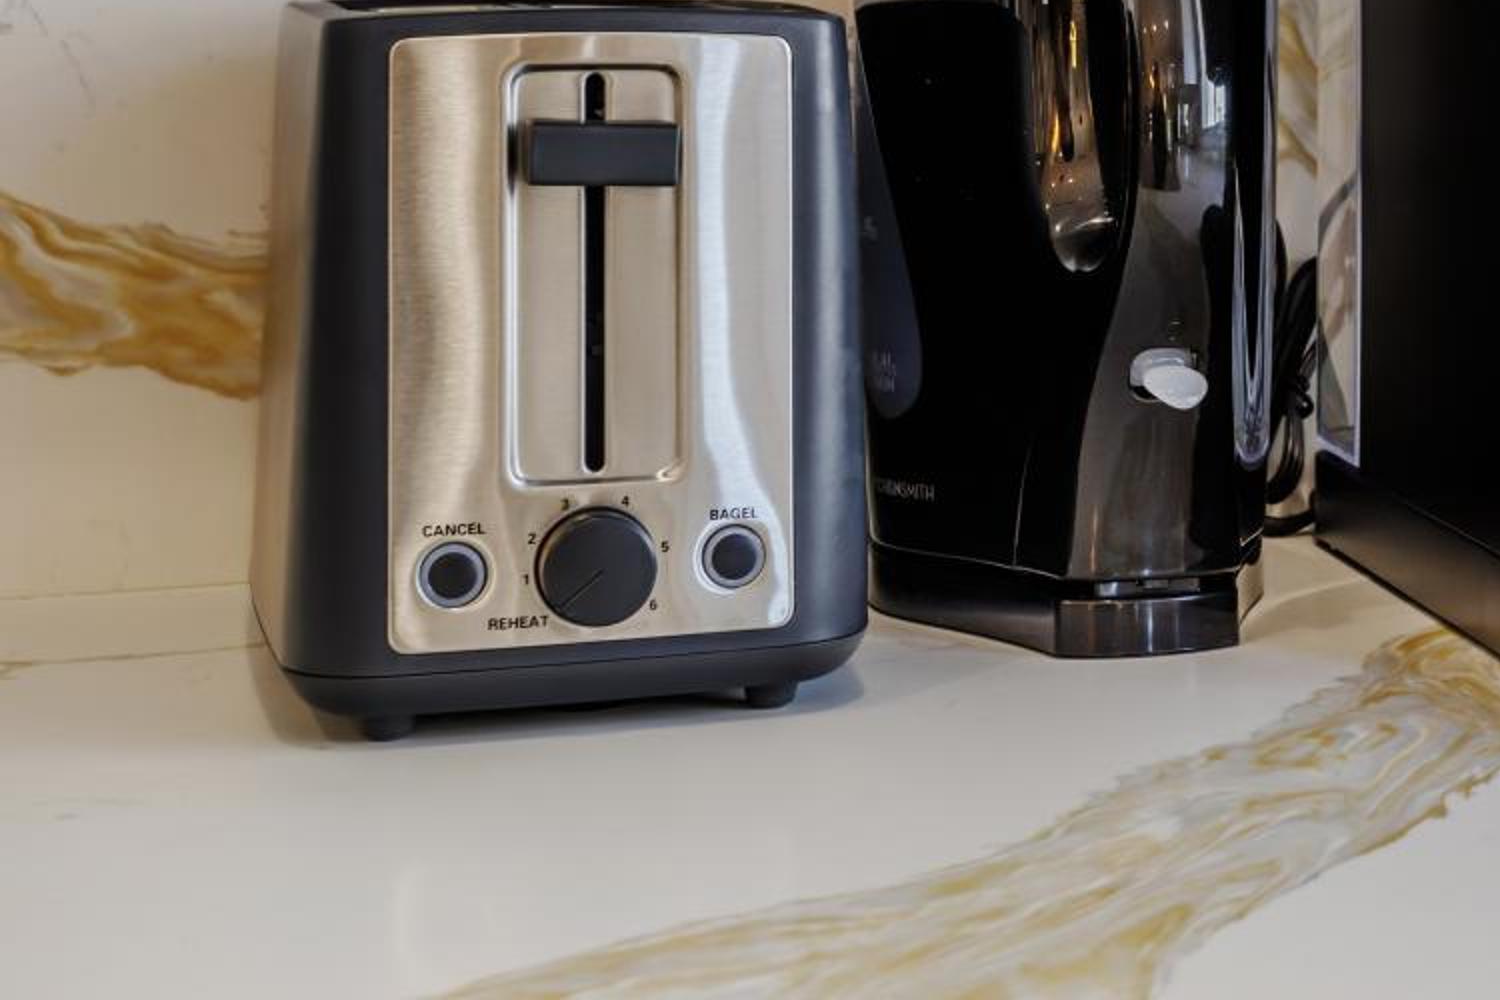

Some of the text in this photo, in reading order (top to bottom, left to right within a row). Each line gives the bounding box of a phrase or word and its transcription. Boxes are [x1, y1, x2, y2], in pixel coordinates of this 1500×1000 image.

[561, 498, 570, 511] 3
[621, 495, 630, 507] 4
[709, 506, 761, 521] BAGEL
[421, 522, 487, 538] CANCEL
[527, 533, 537, 545] 2
[660, 541, 670, 553] 5
[522, 573, 529, 585] 1
[649, 599, 658, 611] 6
[486, 614, 550, 631] REHEAT
